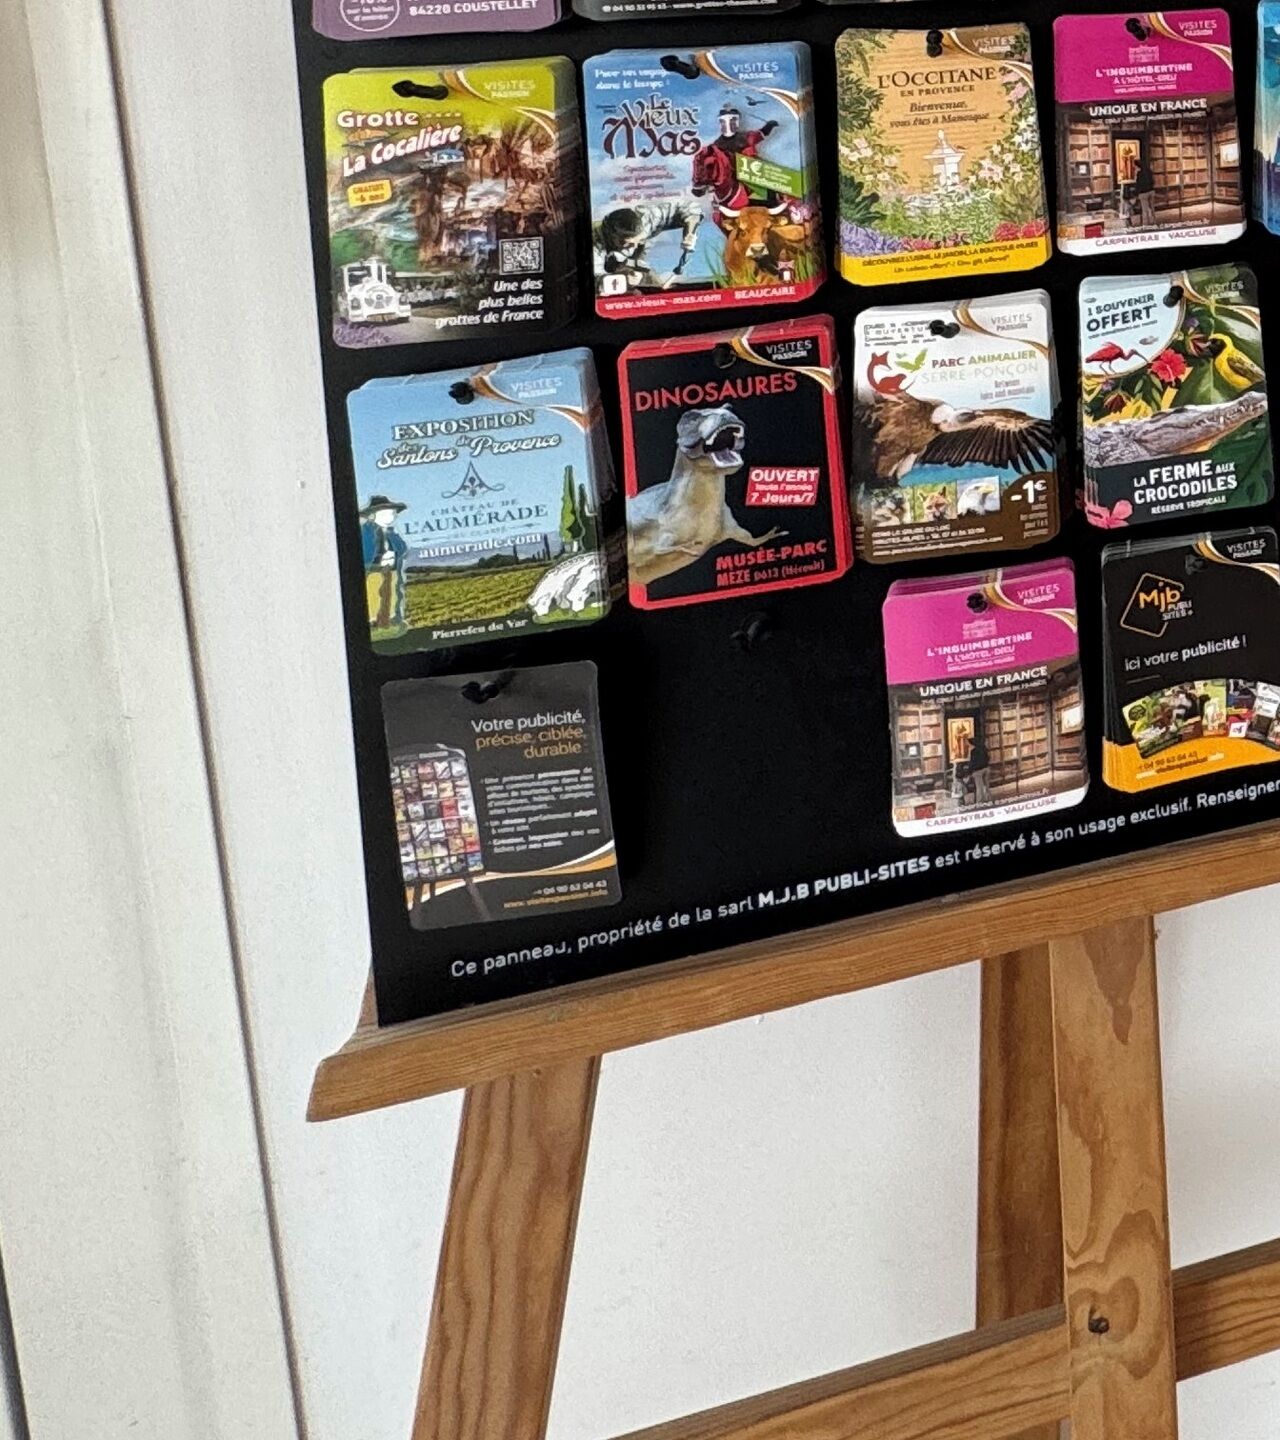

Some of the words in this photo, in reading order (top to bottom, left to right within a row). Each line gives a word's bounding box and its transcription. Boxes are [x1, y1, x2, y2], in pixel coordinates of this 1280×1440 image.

[876, 65, 999, 91] L'OCCITANE
[899, 87, 916, 98] EN
[917, 84, 977, 97] PROVENCE
[335, 109, 421, 129] Grotte
[1088, 101, 1139, 118] UNIQUE
[1140, 101, 1159, 113] EN
[1159, 97, 1209, 112] FRANCE
[342, 154, 368, 178] La
[370, 121, 464, 167] Cocalière
[602, 115, 702, 160] Mas
[930, 355, 966, 370] PARC
[967, 349, 1038, 367] ANIMALIER
[633, 370, 800, 412] DINOSAURES
[391, 408, 536, 442] EXPOSITION
[749, 469, 820, 483] OUVERT
[1132, 475, 1149, 489] LA
[1148, 458, 1214, 486] FERME
[1214, 460, 1237, 474] AUX
[1133, 472, 1239, 506] CROCODILES
[403, 502, 551, 537] L'AUMÉRADE
[715, 539, 829, 572] MUSÉE-PARC
[1124, 657, 1141, 672] ici
[1143, 650, 1180, 668] votre
[1181, 634, 1241, 662] publicité
[918, 680, 974, 698] UNIQUE
[975, 675, 995, 690] EN
[995, 664, 1050, 686] FRANCE
[469, 718, 515, 734] Votre
[516, 709, 587, 733] publicité,
[523, 740, 583, 760] durable
[450, 960, 477, 978] Ce
[576, 914, 665, 954] propriété
[667, 908, 692, 929] de
[694, 905, 713, 923] la
[716, 890, 753, 919] sarl
[756, 879, 811, 909] M.J.B
[813, 855, 933, 897] PUBLI-SITES
[933, 847, 962, 868] est
[963, 832, 1028, 861] réservé
[1030, 831, 1042, 847] à
[1043, 825, 1076, 843] son
[1077, 814, 1128, 840] usage
[1129, 795, 1193, 825] exclusif.
